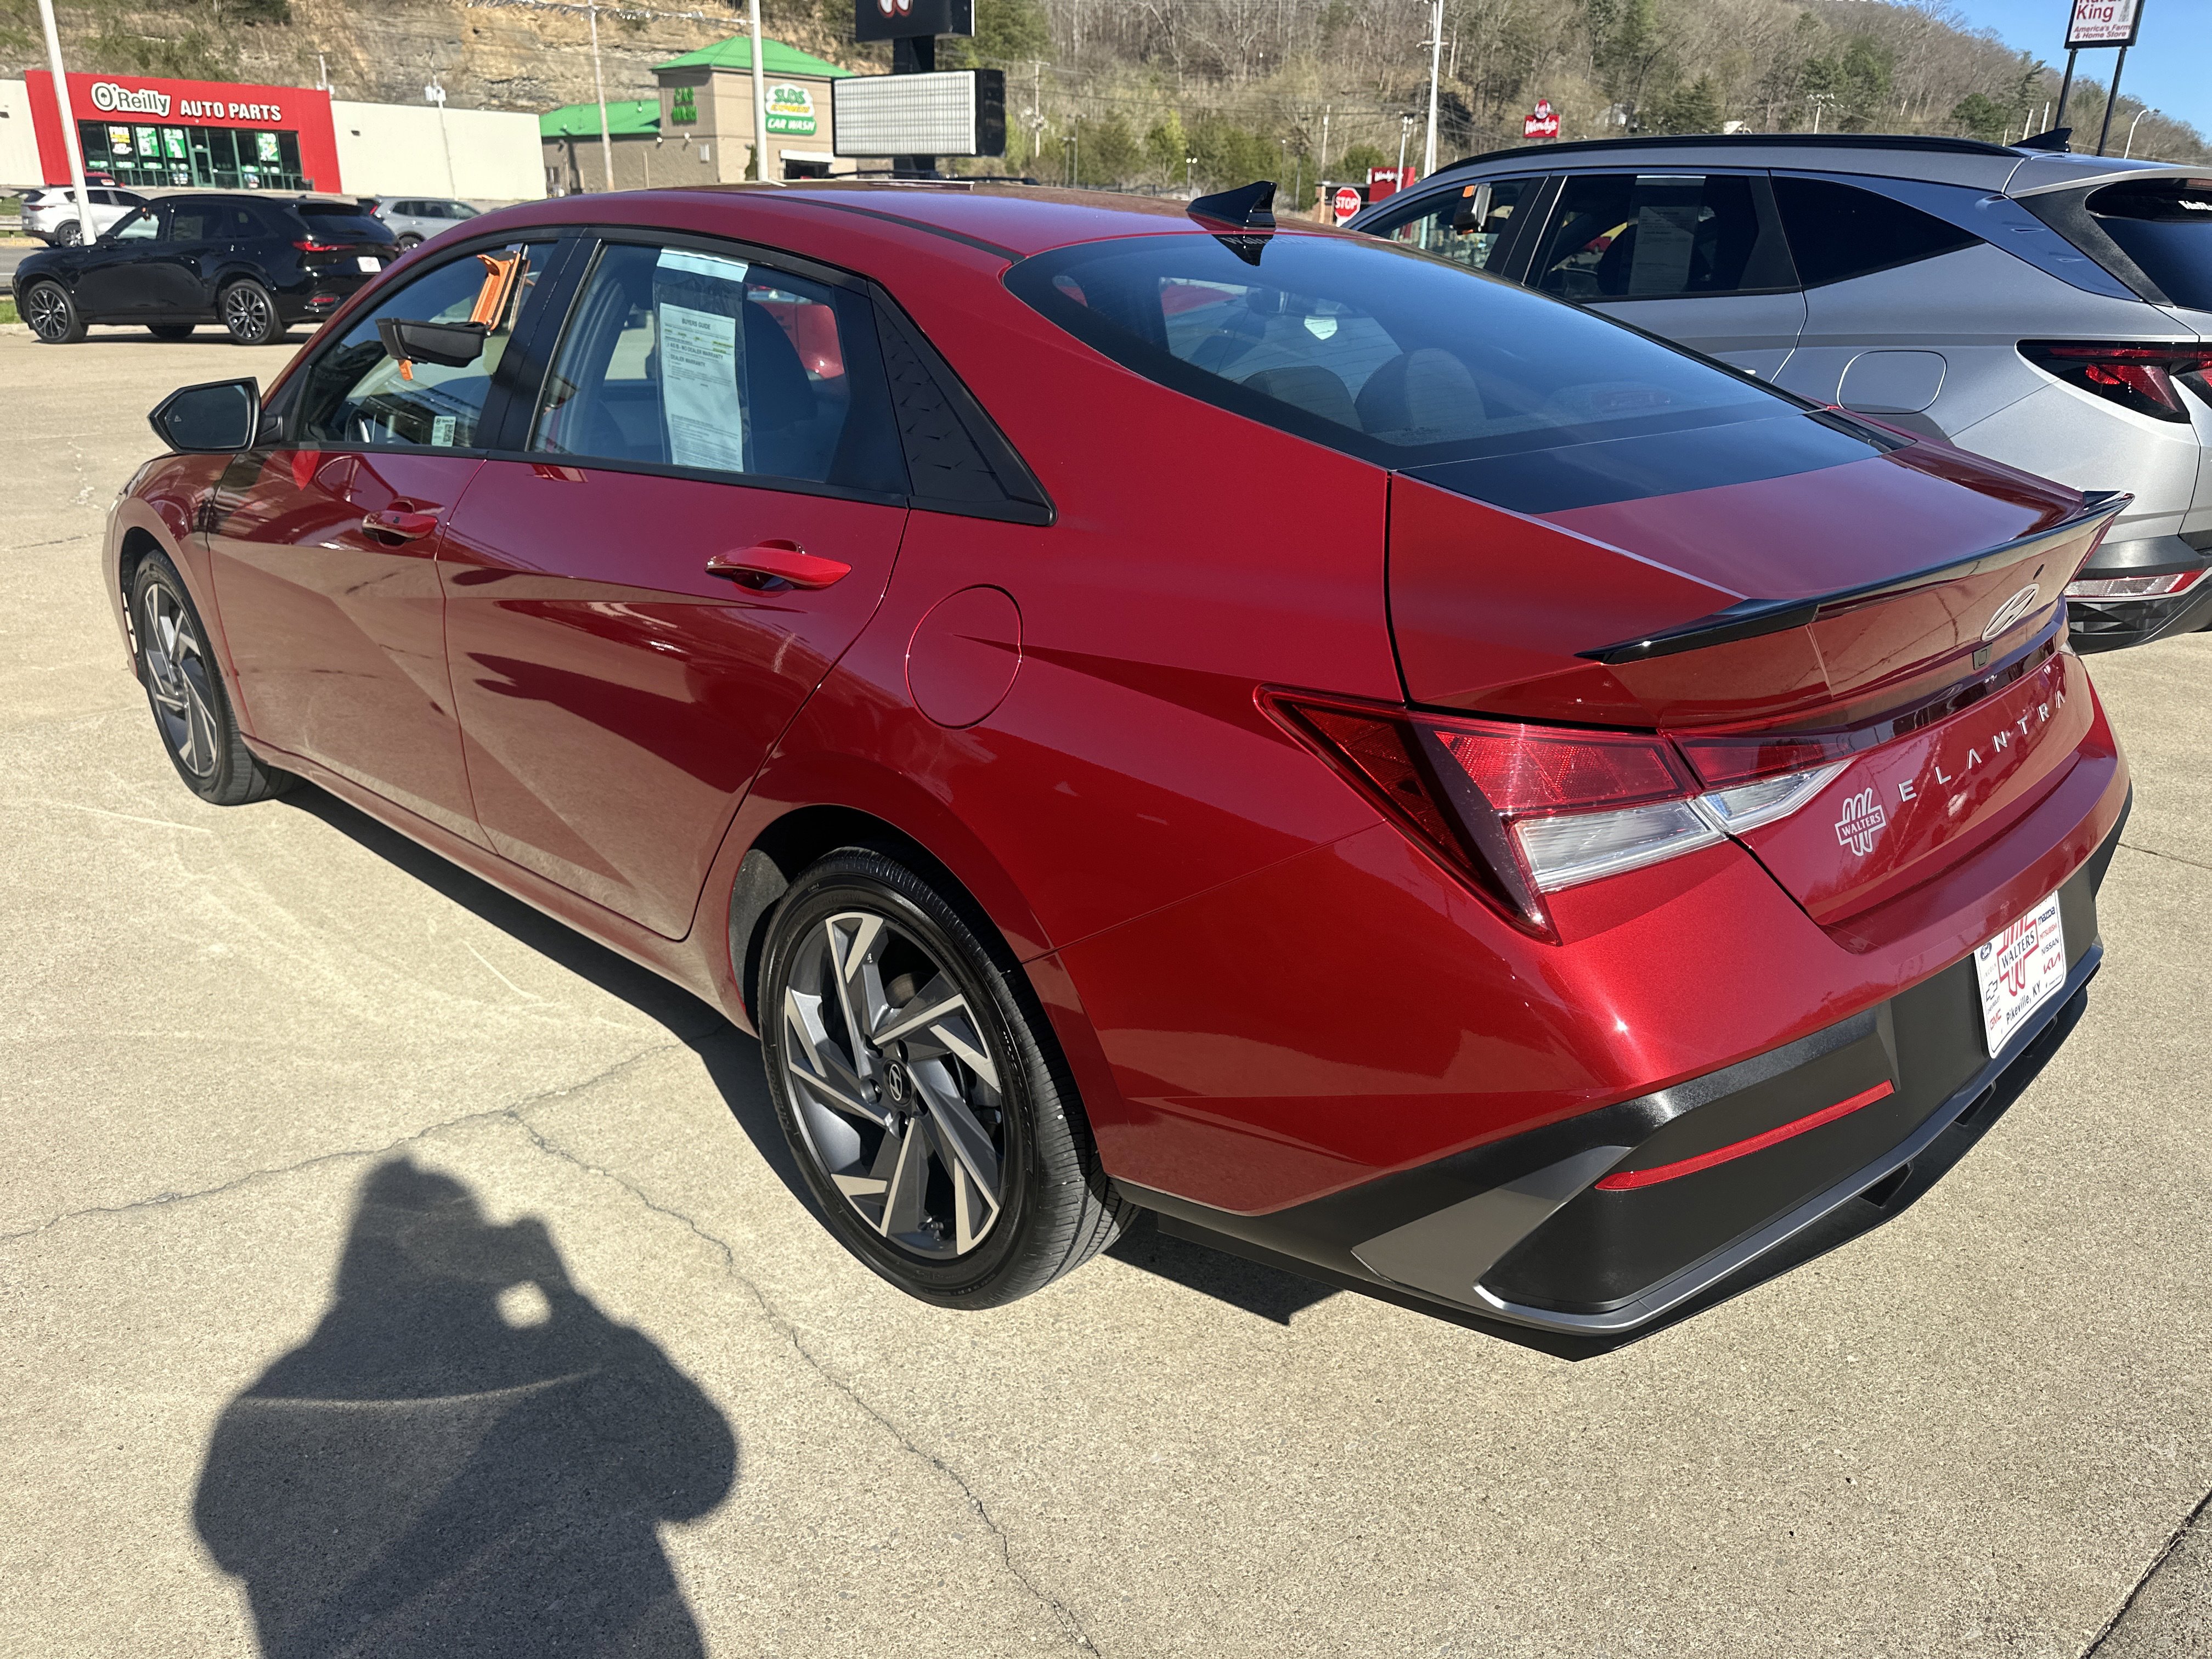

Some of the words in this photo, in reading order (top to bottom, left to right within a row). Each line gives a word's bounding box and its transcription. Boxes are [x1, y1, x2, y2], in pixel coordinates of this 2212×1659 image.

[2076, 4, 2114, 22] King
[94, 85, 167, 113] O'Reilly
[774, 88, 805, 104] SUDS
[180, 99, 225, 118] AUTO
[228, 102, 282, 121] PARTS
[768, 117, 787, 129] CAR
[788, 119, 815, 131] WASH
[1335, 196, 1358, 210] STOP
[1898, 690, 2066, 802] ELANTRA
[1841, 812, 1881, 837] WALTERS
[2038, 906, 2056, 926] mazda
[2040, 922, 2058, 940] MITSUBISHI
[2001, 930, 2035, 969] WALTERS
[2041, 936, 2059, 956] NISSAN
[2043, 952, 2061, 975] KIA
[2006, 995, 2032, 1025] Pikeville,
[2033, 980, 2041, 998] KY
[1989, 1008, 2002, 1031] GMC
